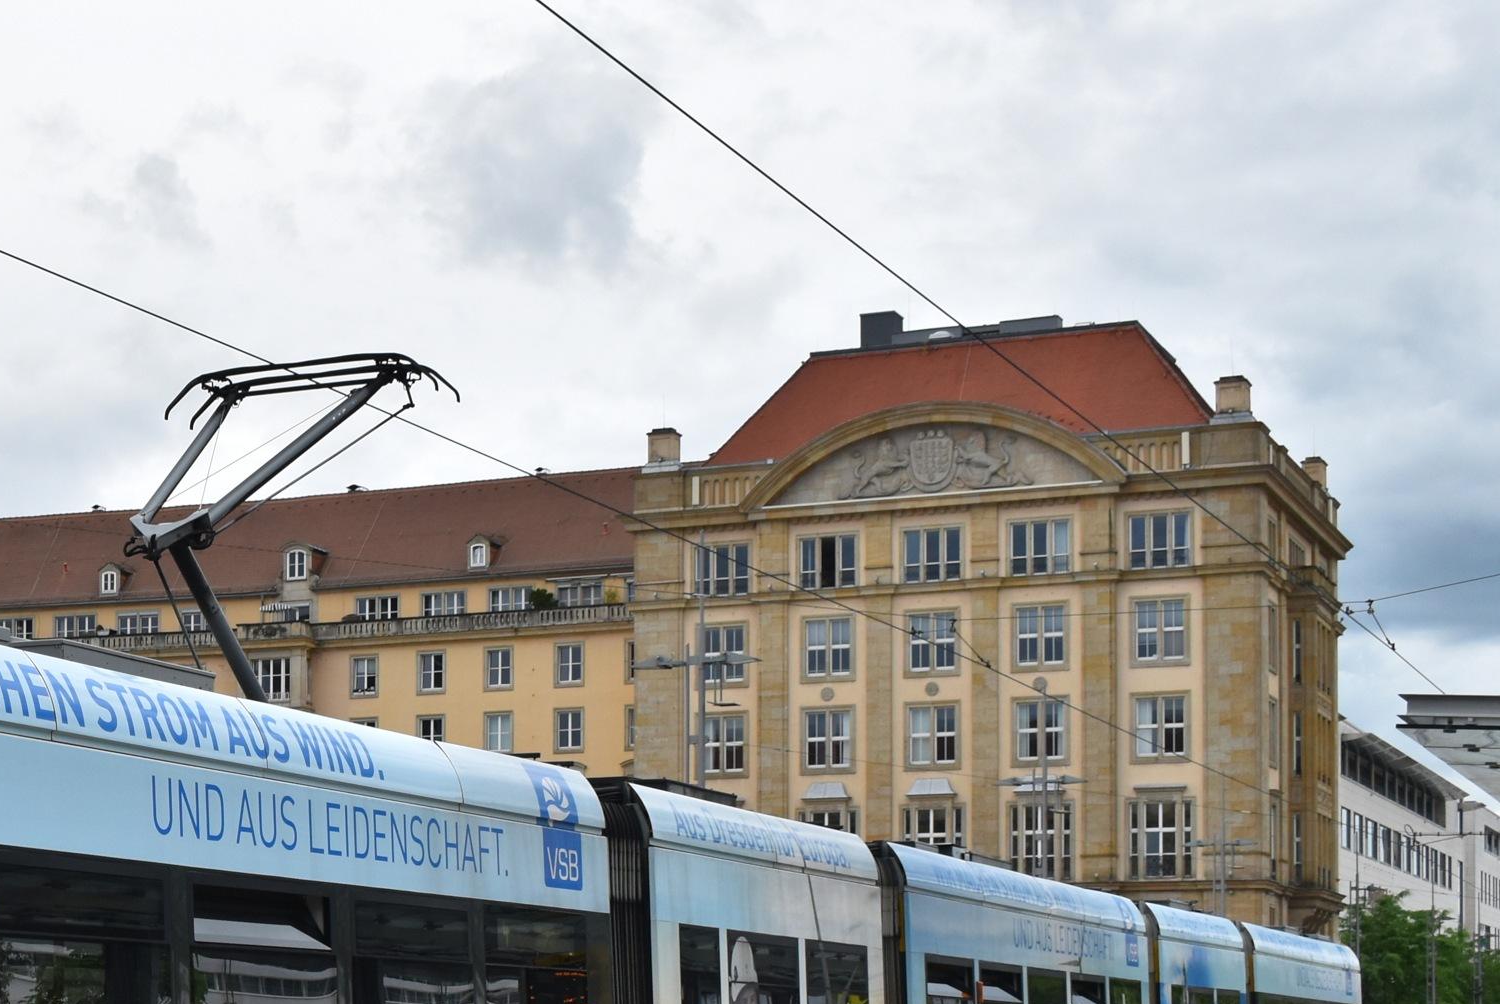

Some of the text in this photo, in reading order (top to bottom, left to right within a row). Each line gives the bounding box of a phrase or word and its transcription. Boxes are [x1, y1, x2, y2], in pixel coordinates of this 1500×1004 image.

[85, 678, 219, 752] STROM
[220, 705, 290, 764] AUS
[284, 718, 385, 781] WIND.
[152, 775, 509, 877] UND AUS LEIDENSCHAFT.
[545, 845, 579, 881] VSB
